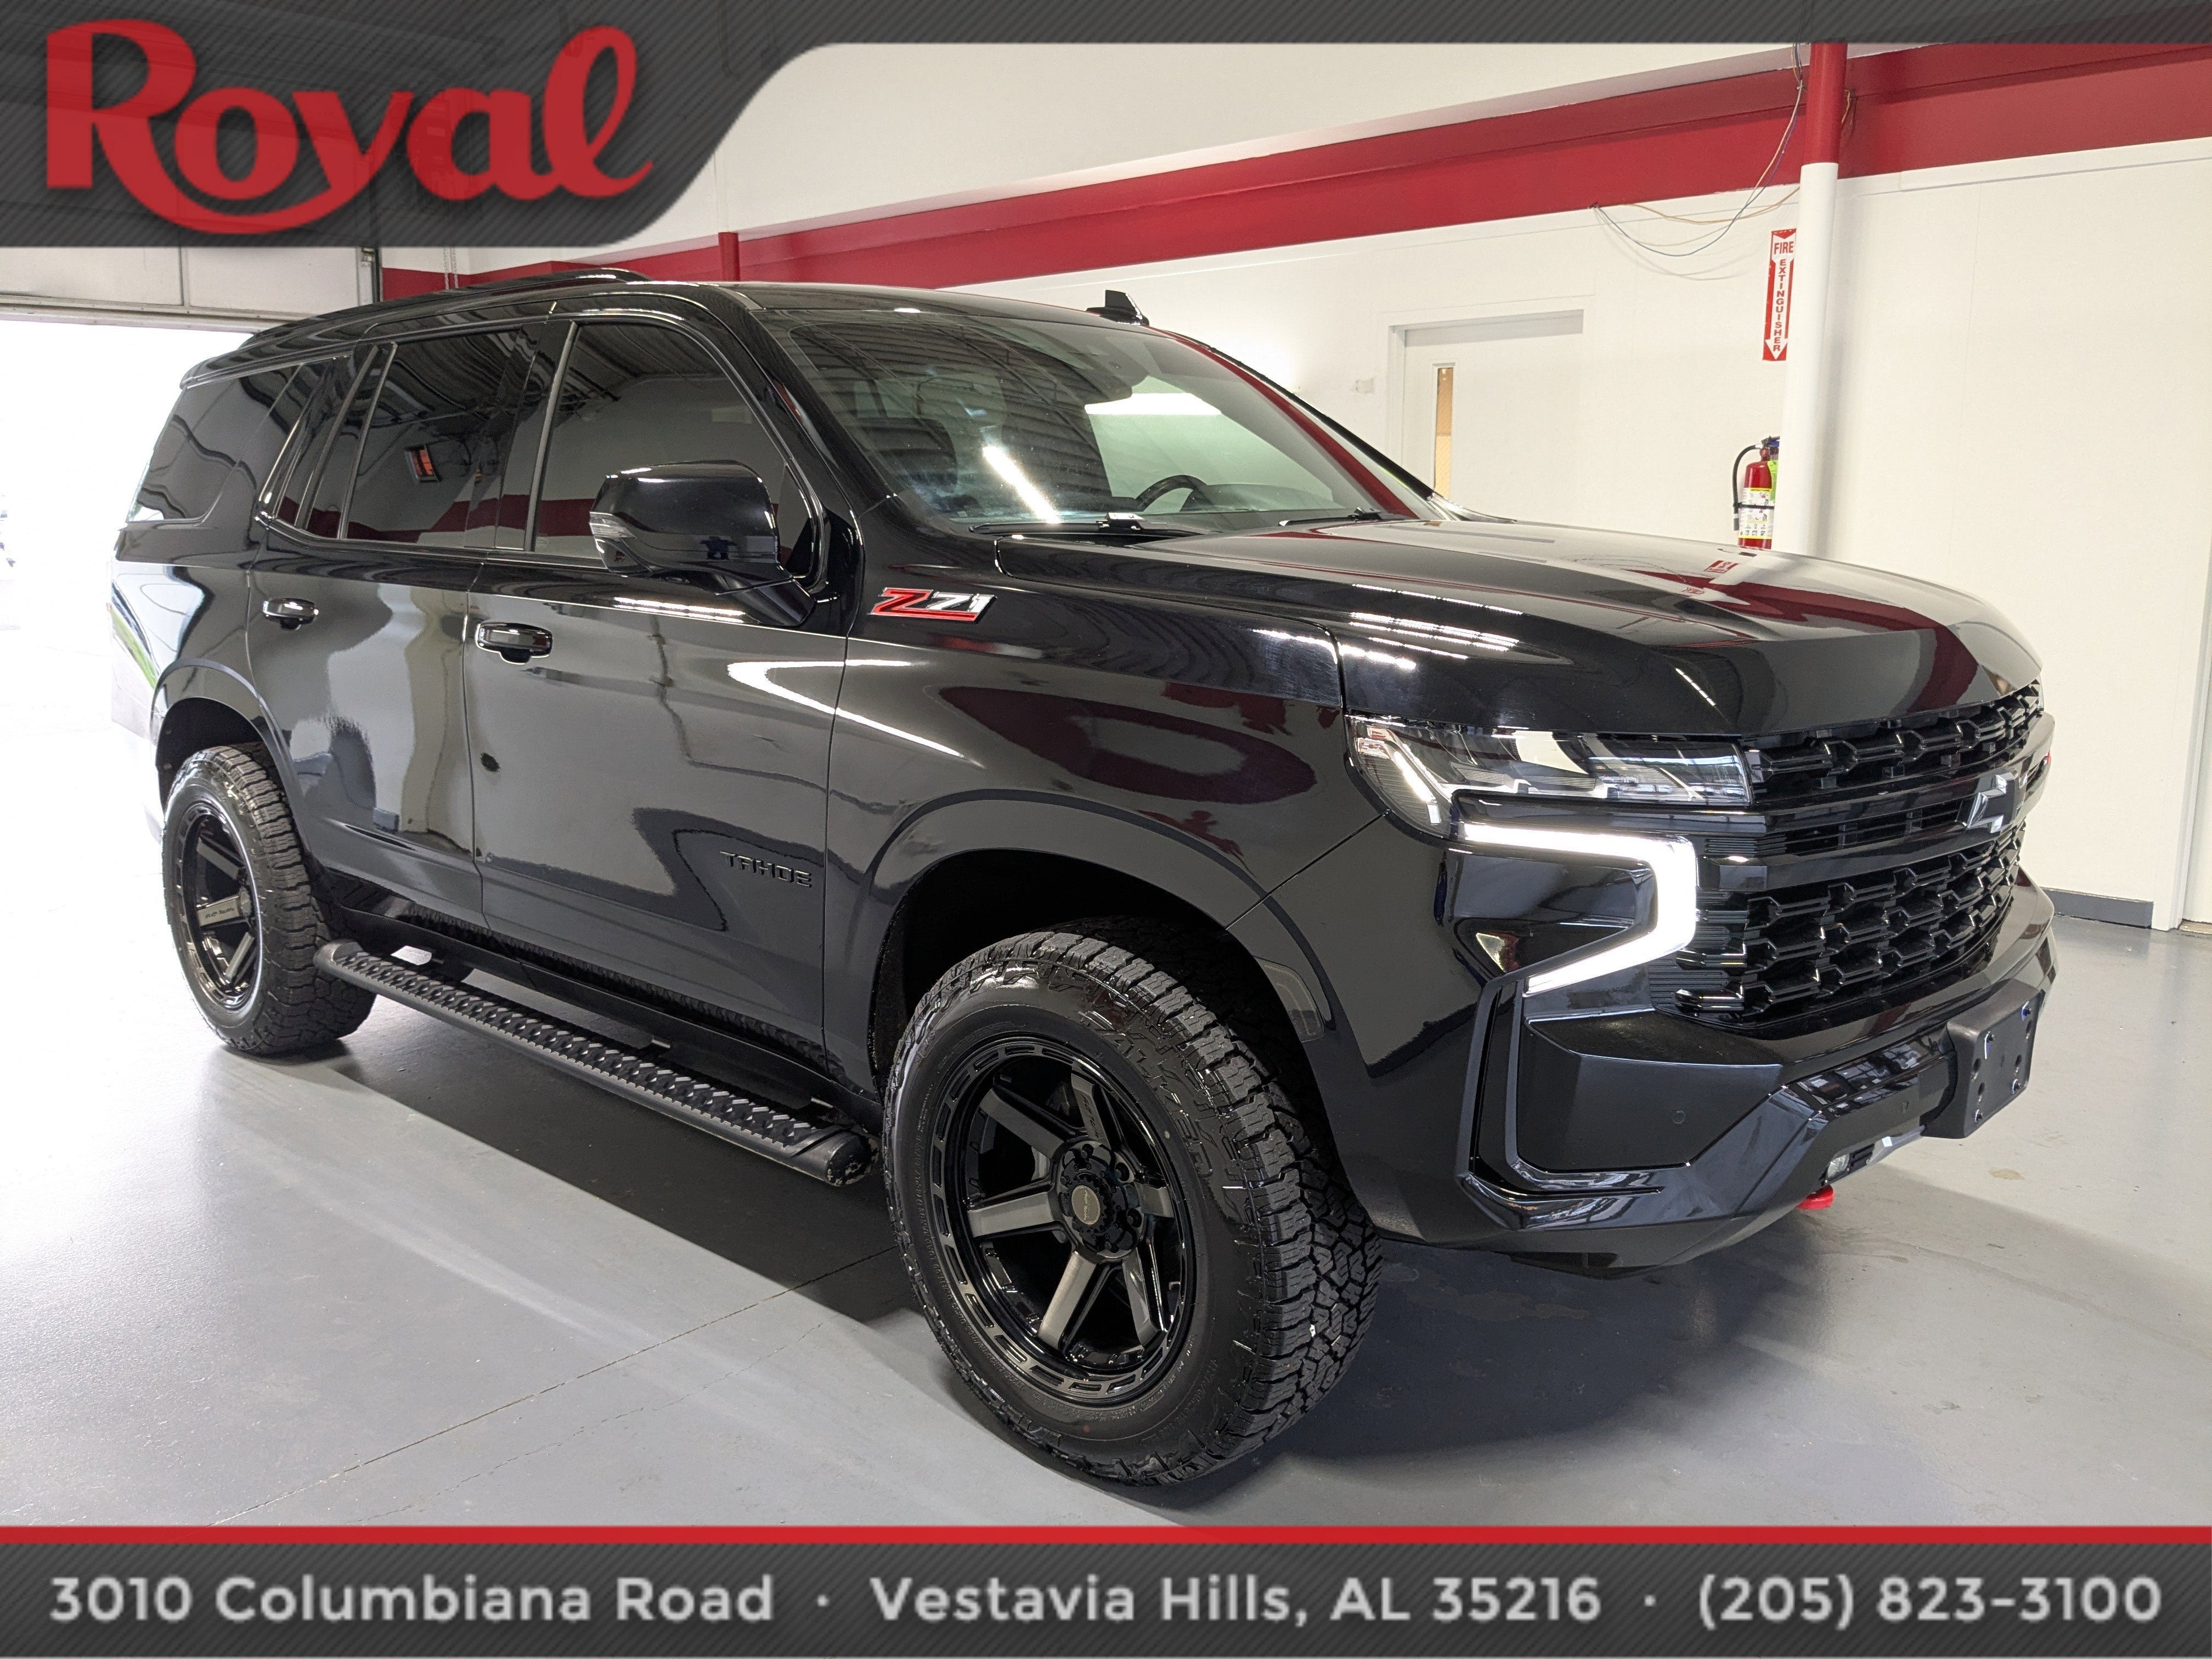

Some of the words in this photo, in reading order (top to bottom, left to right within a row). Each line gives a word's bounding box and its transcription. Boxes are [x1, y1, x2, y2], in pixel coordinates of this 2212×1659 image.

[1774, 241, 1793, 255] FIRE
[1773, 258, 1786, 352] EXTINGUISHER
[867, 587, 997, 622] Z71
[720, 851, 812, 888] TAHOE
